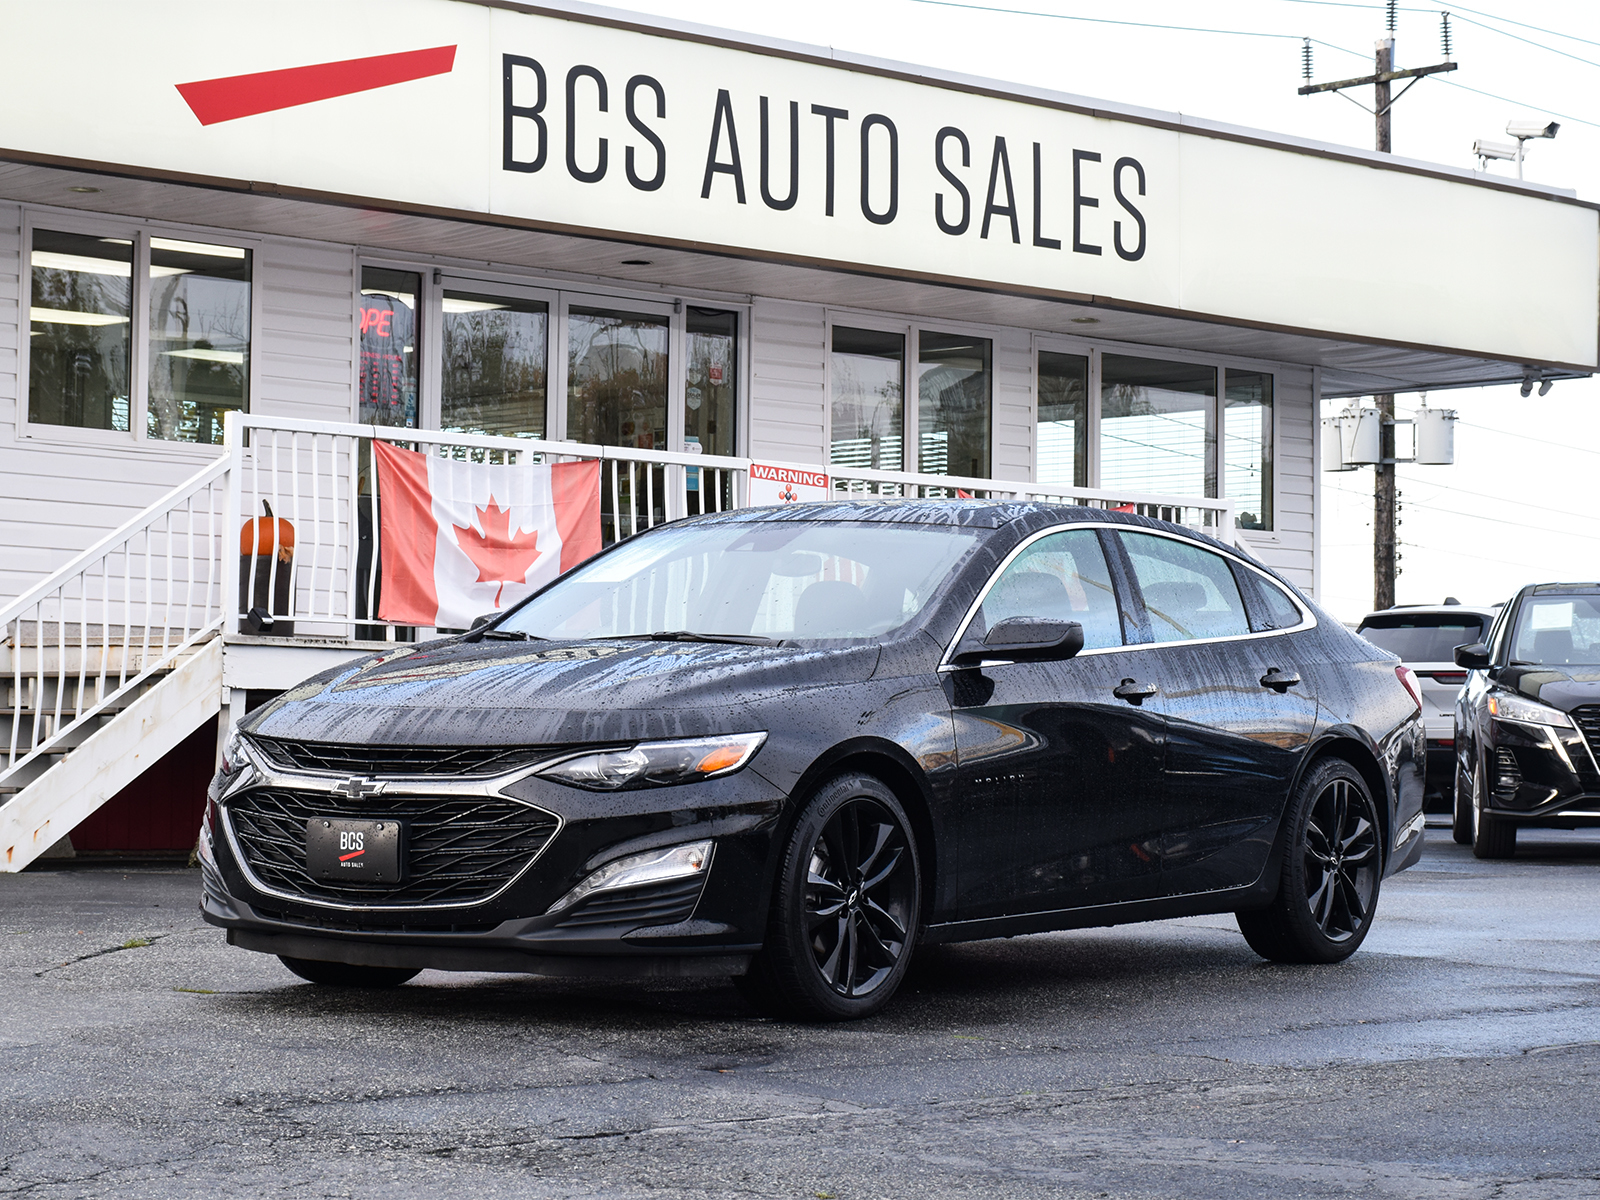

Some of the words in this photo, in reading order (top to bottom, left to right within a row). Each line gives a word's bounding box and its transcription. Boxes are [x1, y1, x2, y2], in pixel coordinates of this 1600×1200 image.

[502, 53, 667, 192] BCS
[700, 88, 899, 225] AUTO
[935, 126, 1146, 262] SALES
[753, 466, 825, 486] WARNING
[817, 782, 849, 818] Continental
[340, 832, 364, 850] BCS
